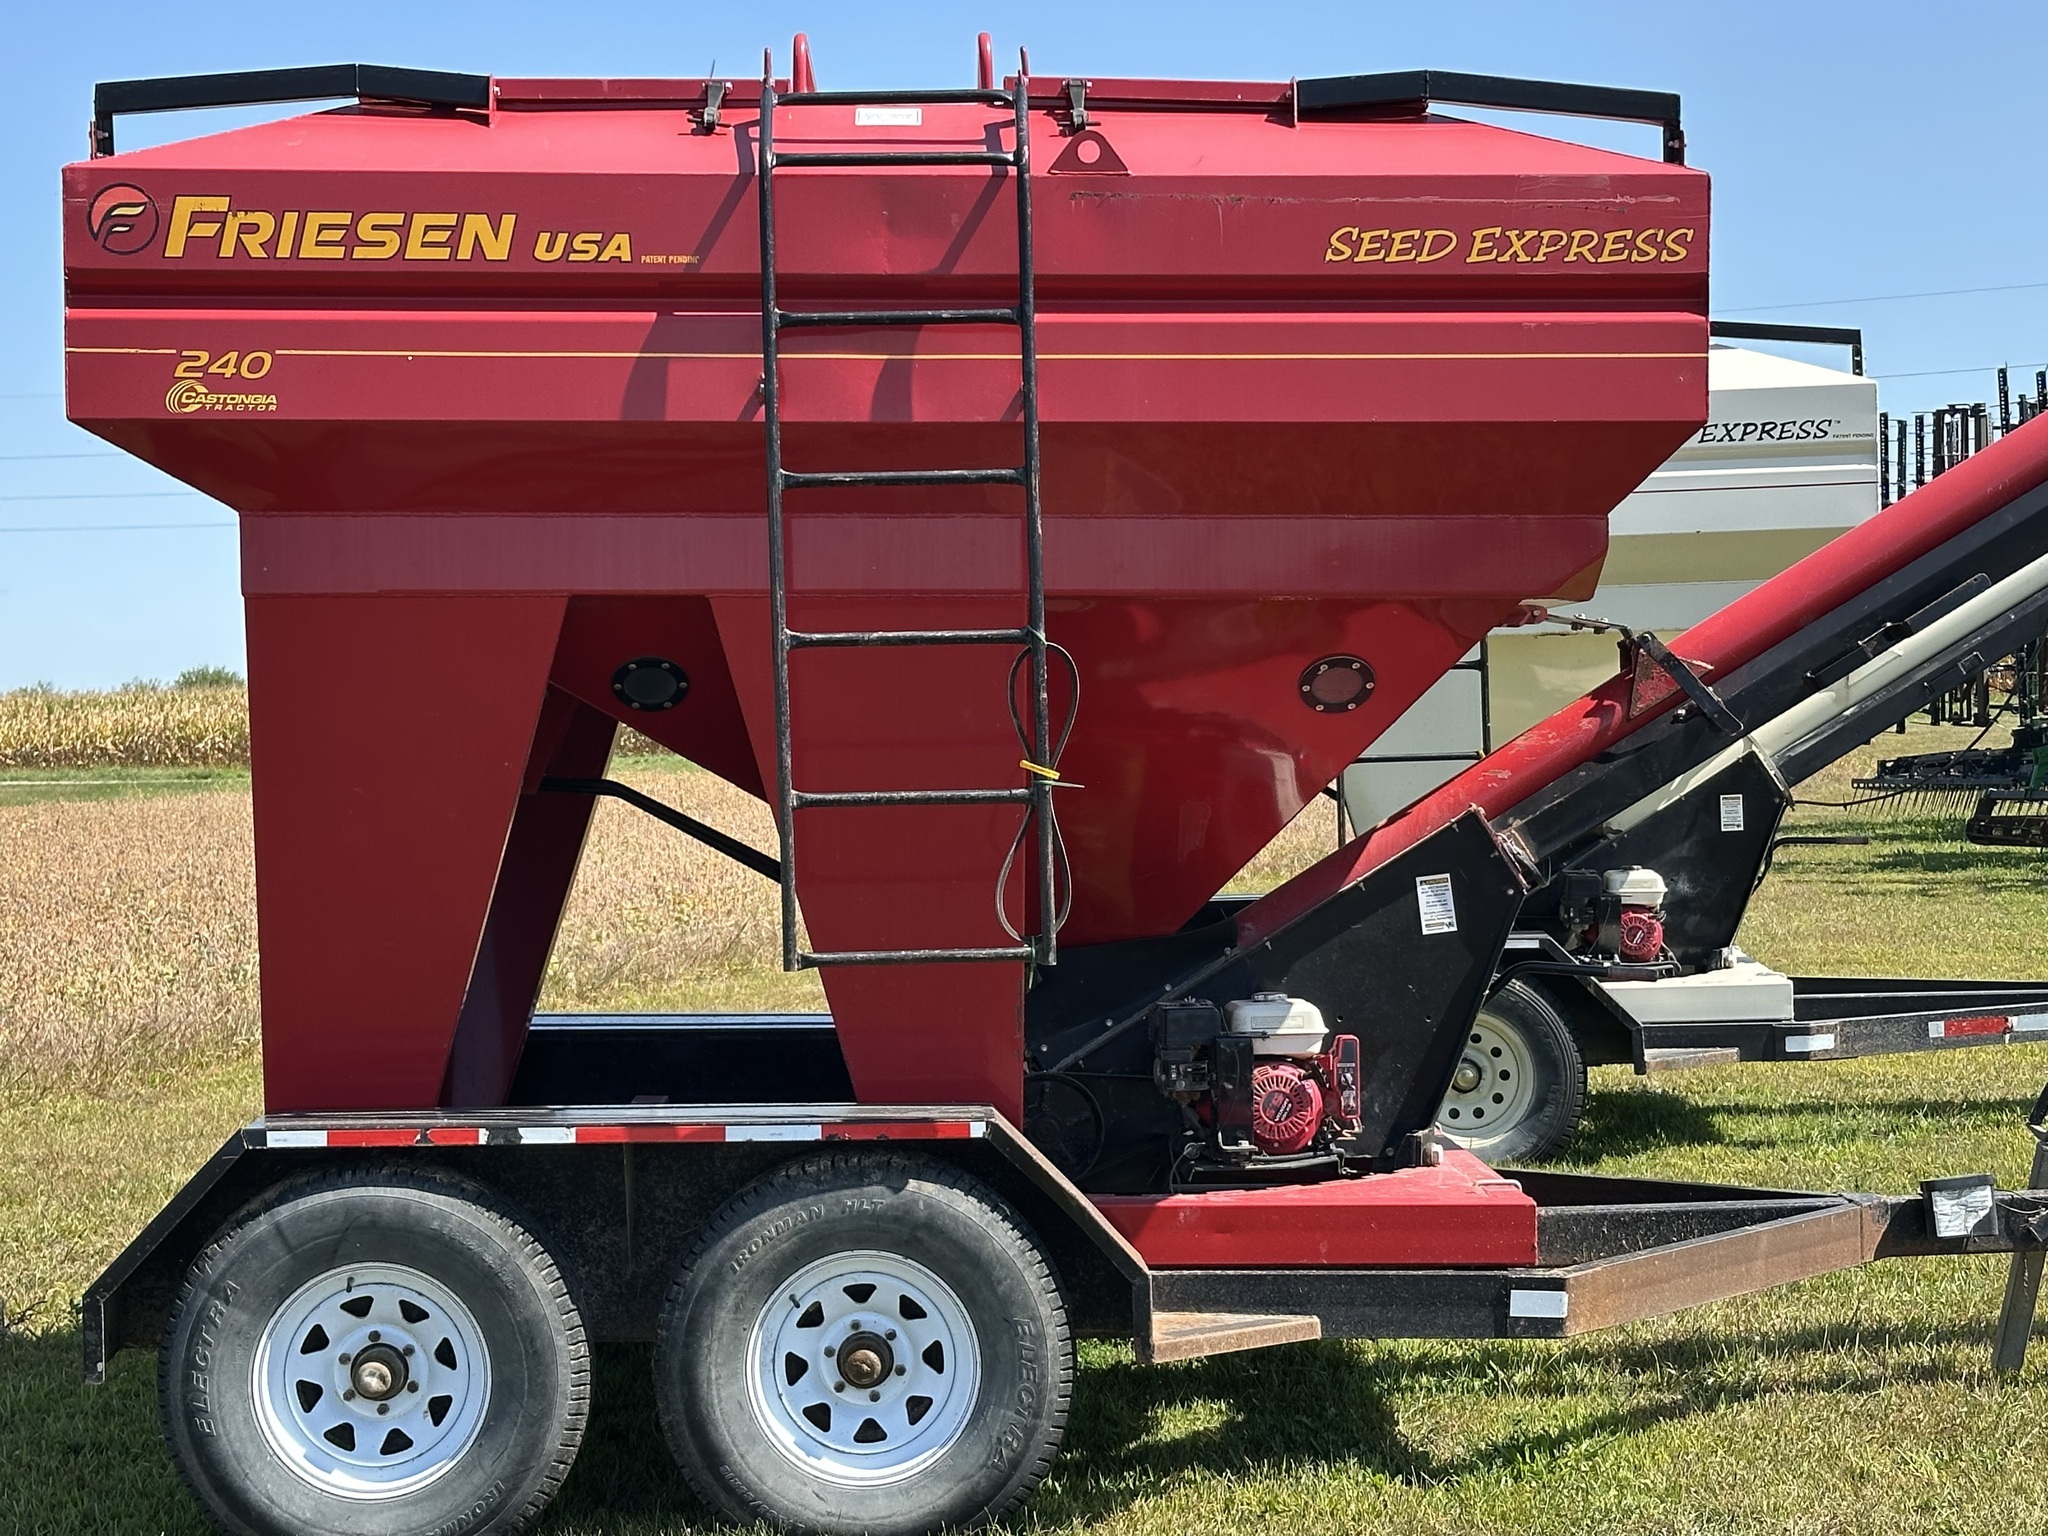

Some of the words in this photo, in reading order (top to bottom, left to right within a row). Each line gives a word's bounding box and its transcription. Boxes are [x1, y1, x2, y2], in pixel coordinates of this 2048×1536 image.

[163, 195, 517, 261] FRIESEN
[533, 231, 632, 262] USA
[1325, 226, 1457, 264] SEED
[1466, 227, 1694, 264] EXPRESS
[641, 255, 666, 263] PATENT
[173, 350, 273, 380] 240
[180, 391, 277, 405] CASTONGIA
[205, 404, 277, 412] TRACTOR
[1698, 418, 1832, 443] EXPRESS
[729, 1204, 825, 1275] IRONMAN
[841, 1199, 885, 1215] HLT
[192, 1279, 241, 1438] ELECTRA
[992, 1317, 1039, 1473] ELECTRA
